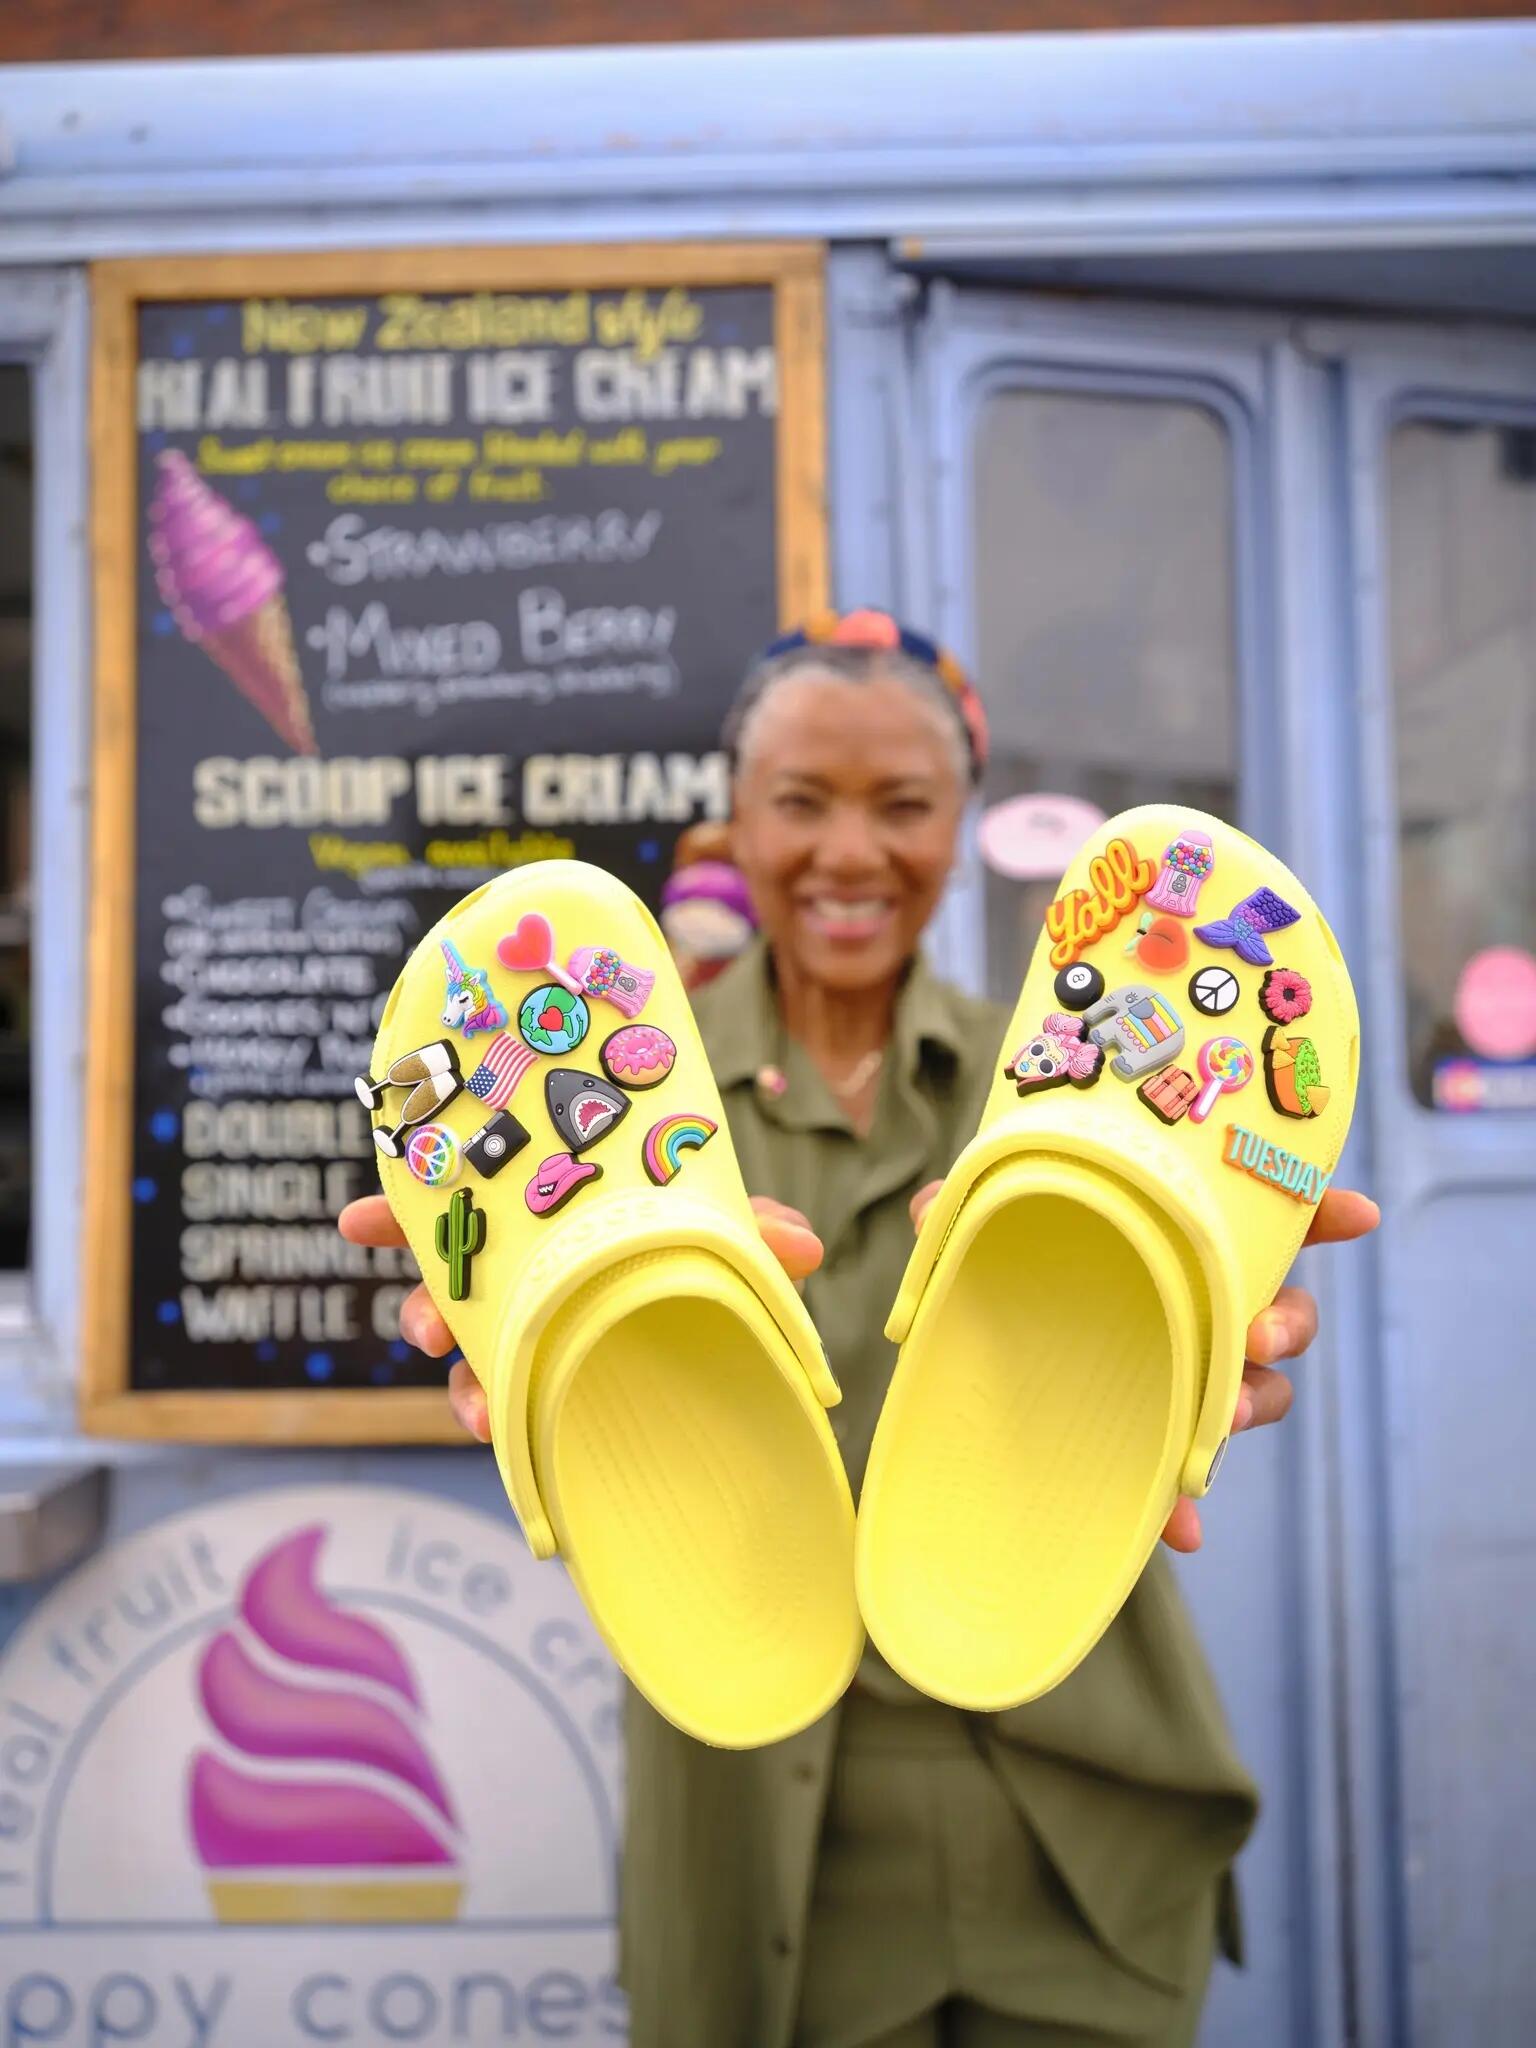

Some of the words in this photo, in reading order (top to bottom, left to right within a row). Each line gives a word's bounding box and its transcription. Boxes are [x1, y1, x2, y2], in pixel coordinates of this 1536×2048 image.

[243, 299, 366, 352] New
[376, 292, 588, 349] Zealand
[596, 286, 702, 361] style
[138, 356, 275, 430] REAL
[287, 353, 453, 426] FRUIT
[467, 350, 552, 423] ICE
[573, 346, 777, 419] CREAM
[424, 469, 459, 502] of
[194, 757, 410, 828] SCOOP
[416, 755, 510, 825] ICE
[523, 752, 731, 825] CREAM
[183, 1101, 373, 1159] DOUBLE
[1229, 1124, 1332, 1205] TUESDAY
[181, 1161, 361, 1221] SINGLE
[180, 1284, 361, 1343] WAFFLE
[48, 1534, 224, 1684] fruit
[386, 1514, 512, 1617] ice
[531, 1618, 625, 1745] cre
[6, 1970, 232, 2048] ppy
[292, 1969, 629, 2040] cones
